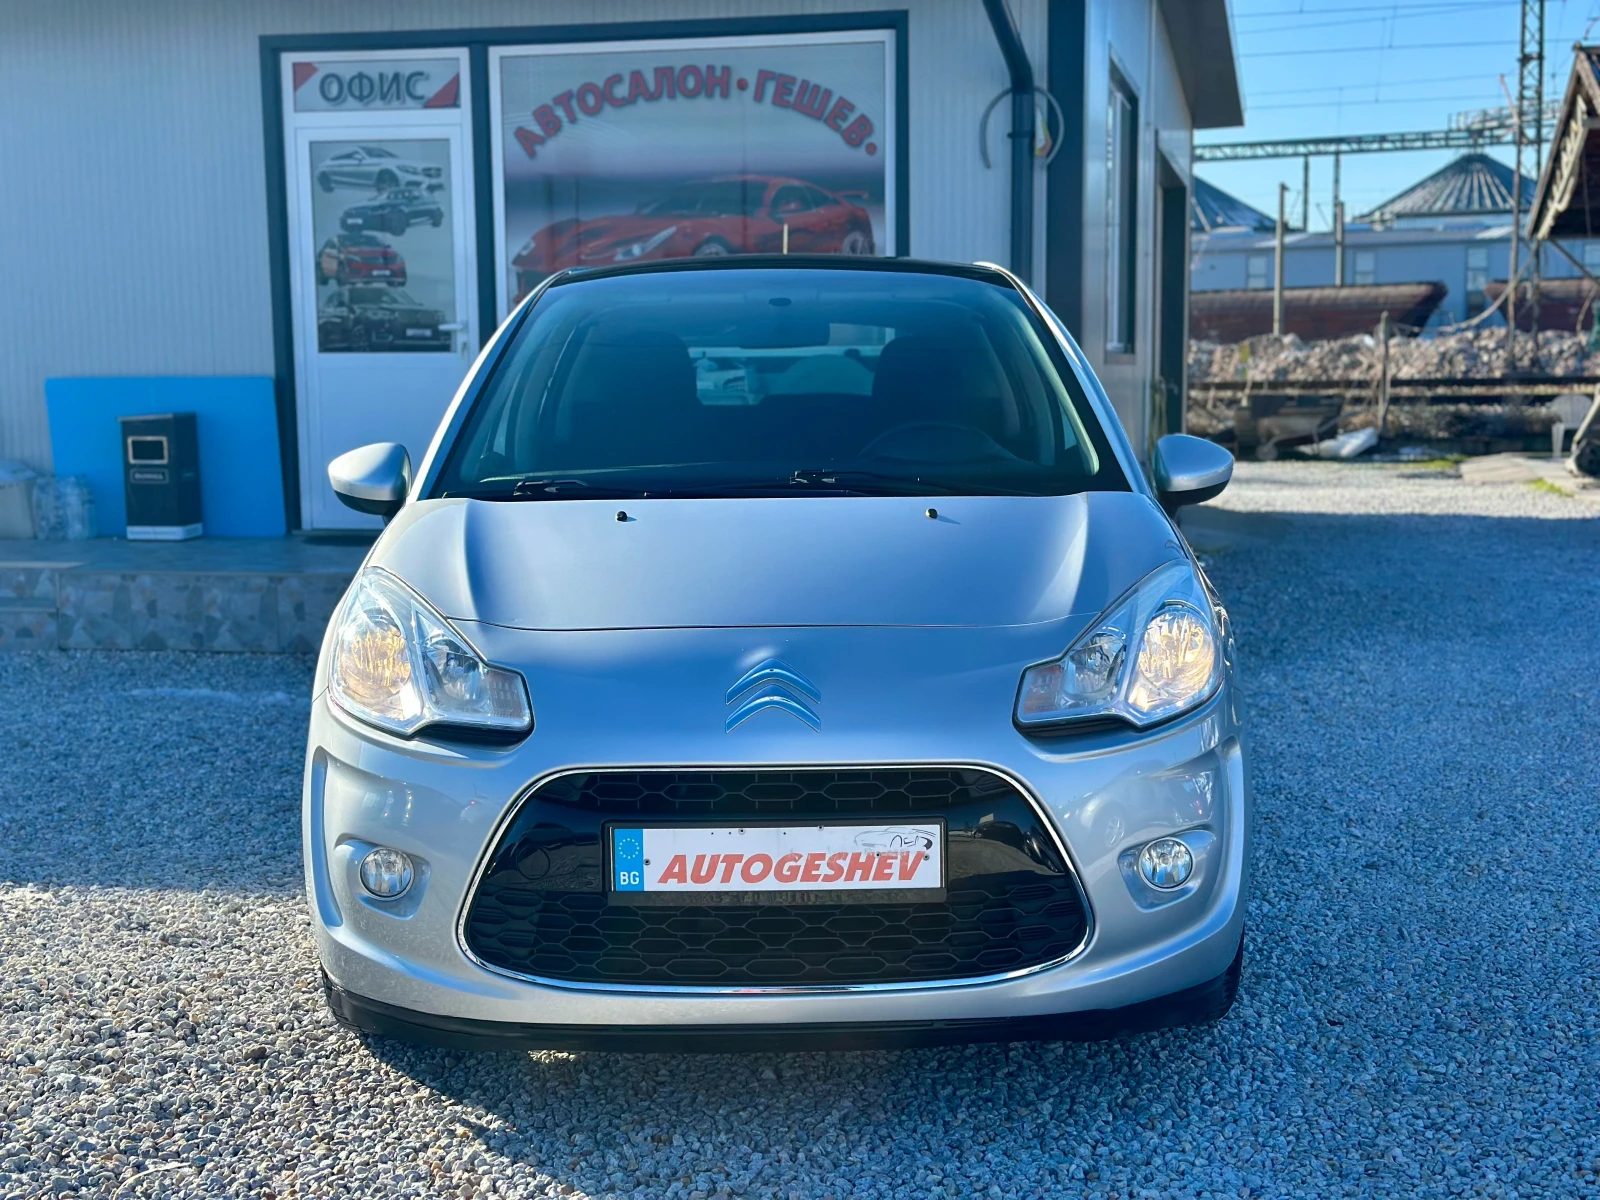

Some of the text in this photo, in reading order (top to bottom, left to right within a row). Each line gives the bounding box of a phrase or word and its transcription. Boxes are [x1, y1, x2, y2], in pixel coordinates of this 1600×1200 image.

[319, 71, 427, 104] ОФИС
[513, 65, 731, 158] АВТОСАЛОН
[620, 871, 640, 886] BG
[657, 851, 926, 884] AUTOGESHEV
